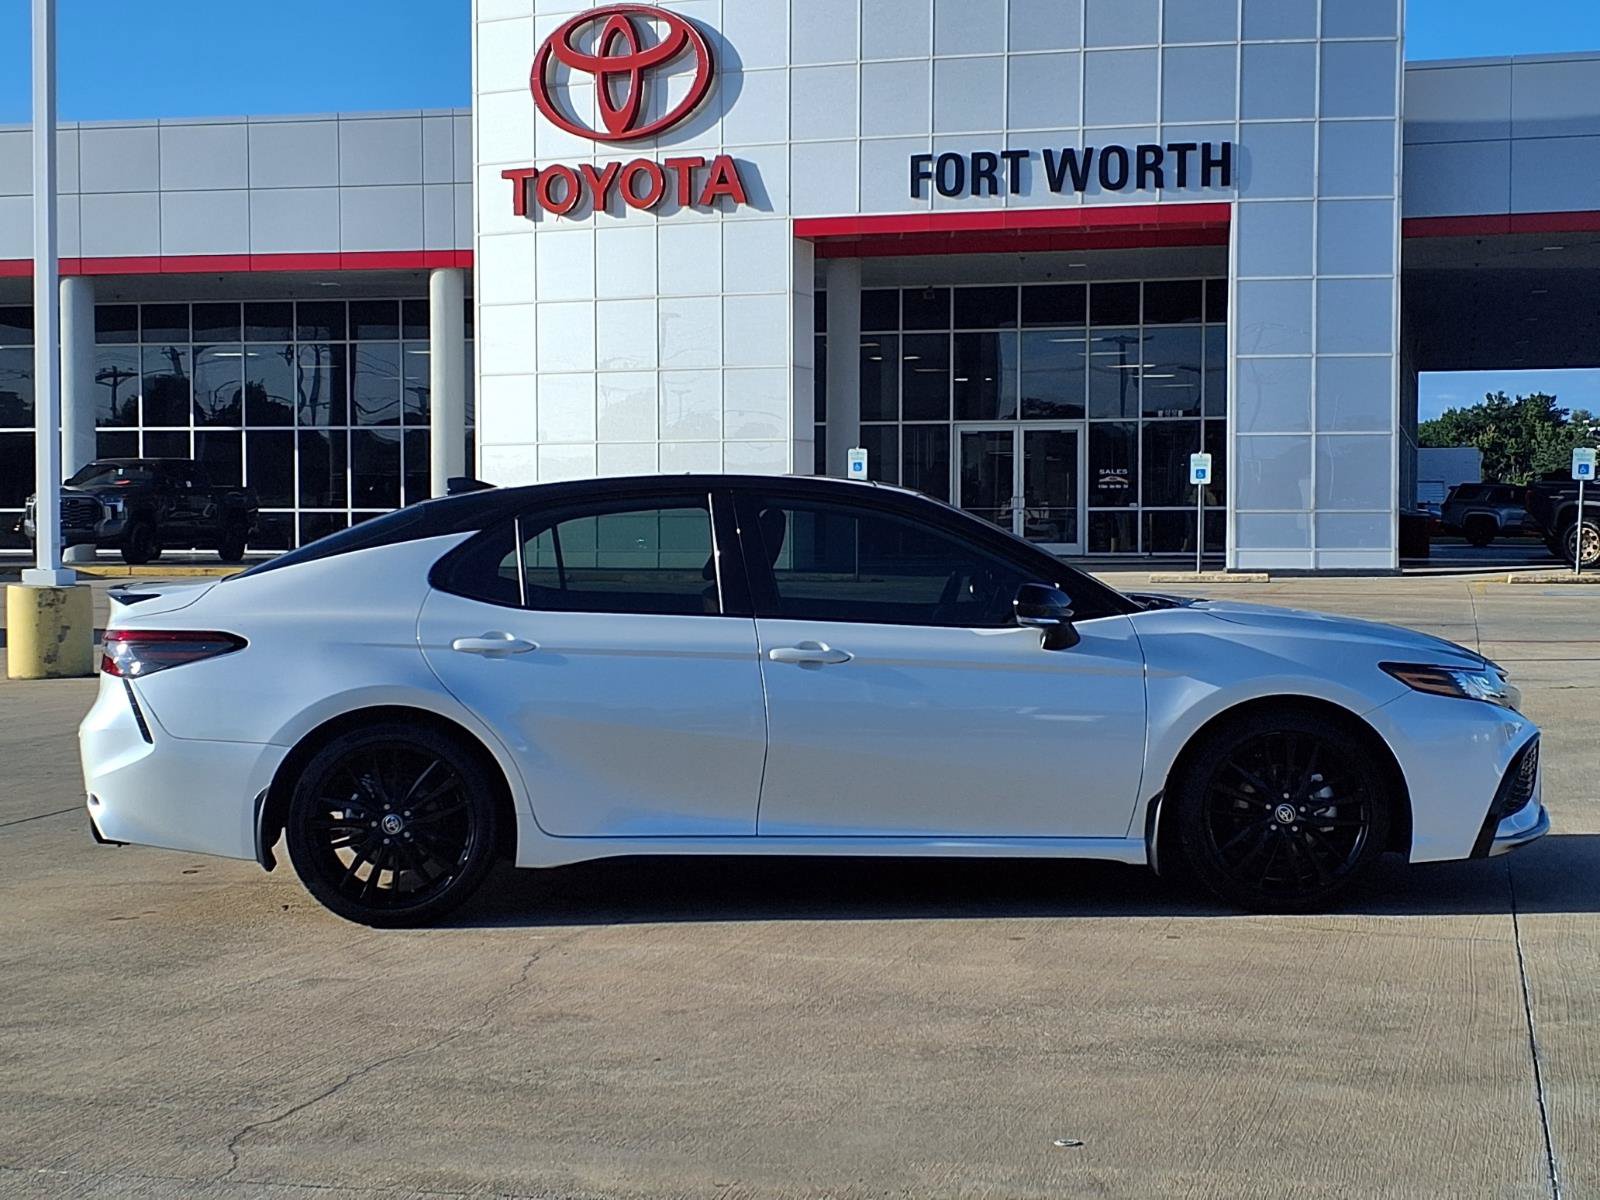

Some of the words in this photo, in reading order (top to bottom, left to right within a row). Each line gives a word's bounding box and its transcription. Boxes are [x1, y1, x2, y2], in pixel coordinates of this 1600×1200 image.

[501, 154, 748, 217] TOYOTA
[910, 149, 1030, 199] FORT
[1042, 141, 1232, 193] WORTH
